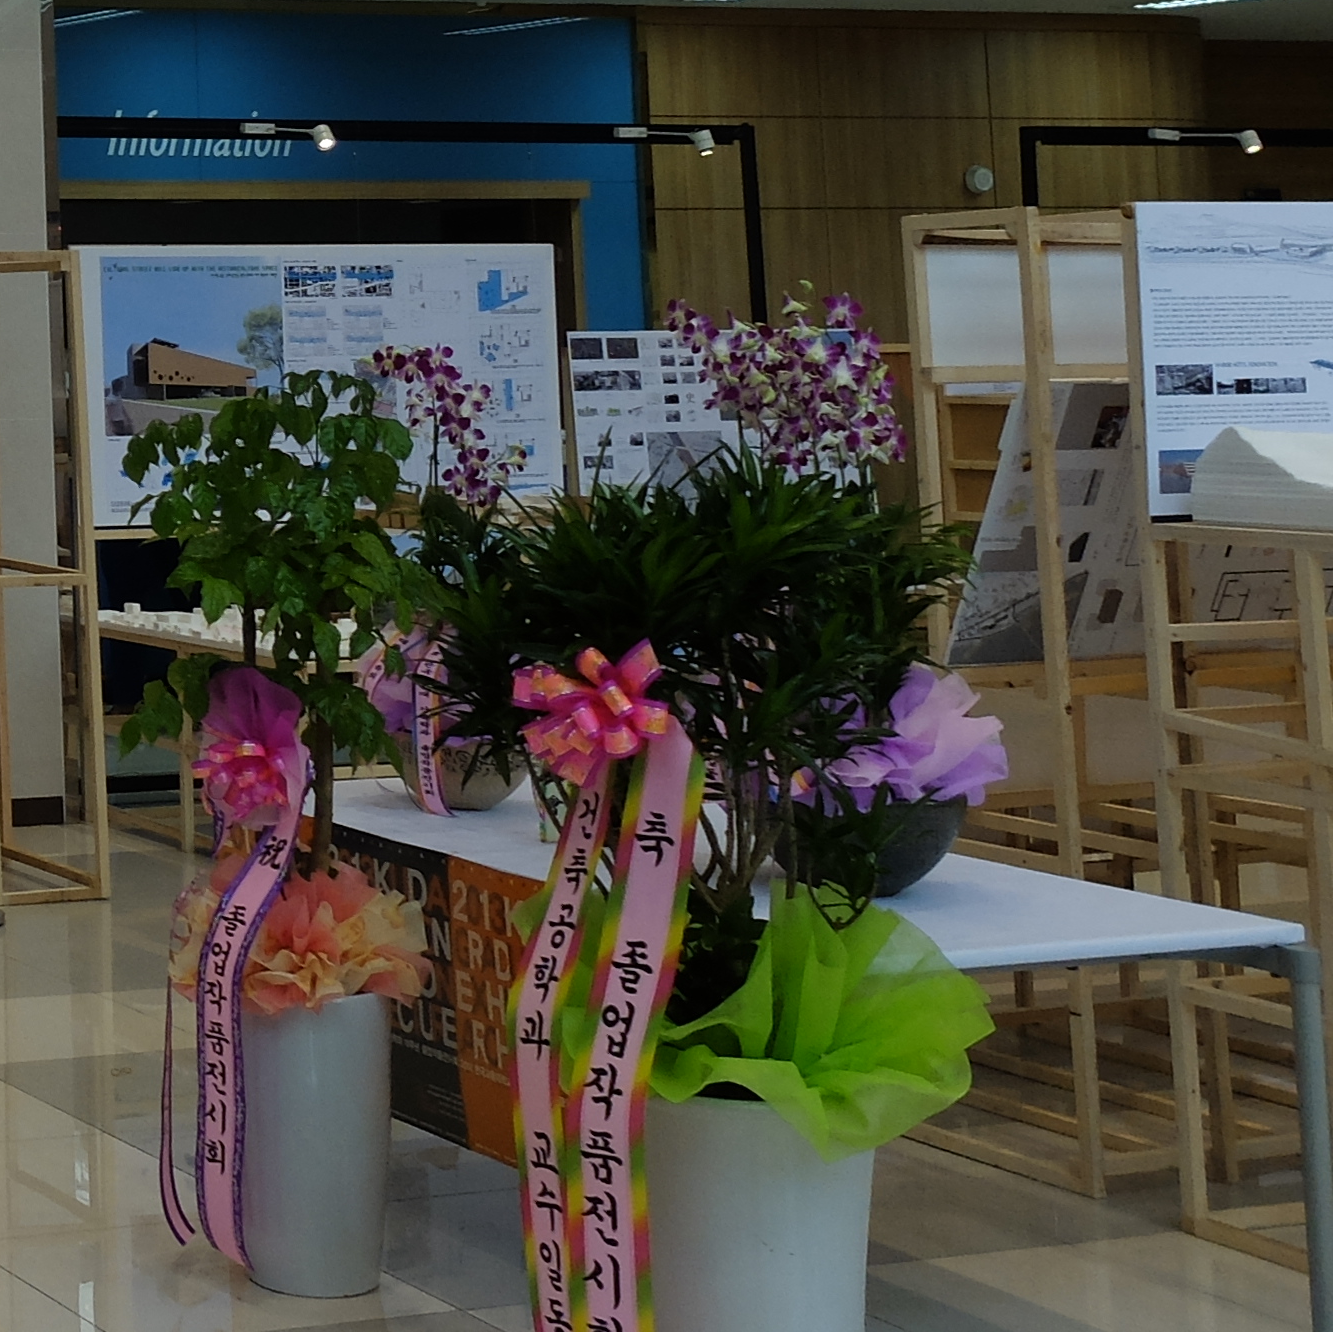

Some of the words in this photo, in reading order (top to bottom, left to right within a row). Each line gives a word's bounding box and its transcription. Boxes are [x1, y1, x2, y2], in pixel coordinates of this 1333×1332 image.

[520, 791, 600, 1062] 건축공학과
[634, 810, 676, 867] 축
[203, 904, 247, 1175] 졸업작품전시회
